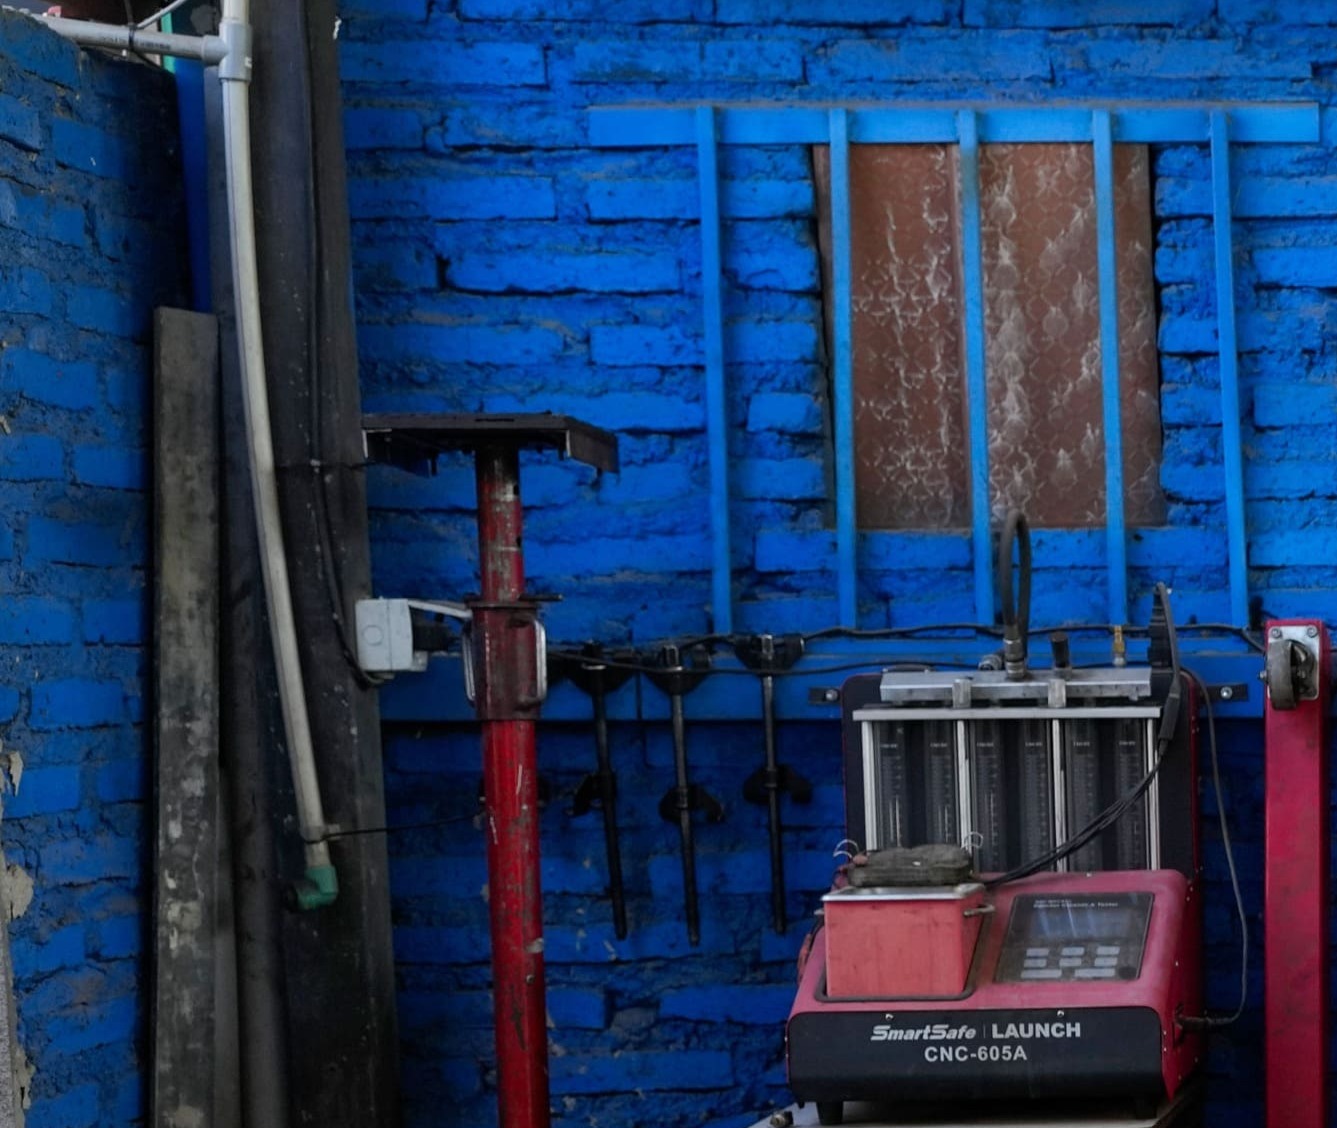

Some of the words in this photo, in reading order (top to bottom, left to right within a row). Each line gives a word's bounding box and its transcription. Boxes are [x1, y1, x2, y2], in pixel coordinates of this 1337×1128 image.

[870, 1024, 976, 1041] SmartSafe
[991, 1022, 1081, 1039] LAUNCH
[924, 1046, 1027, 1063] CNC-605A
